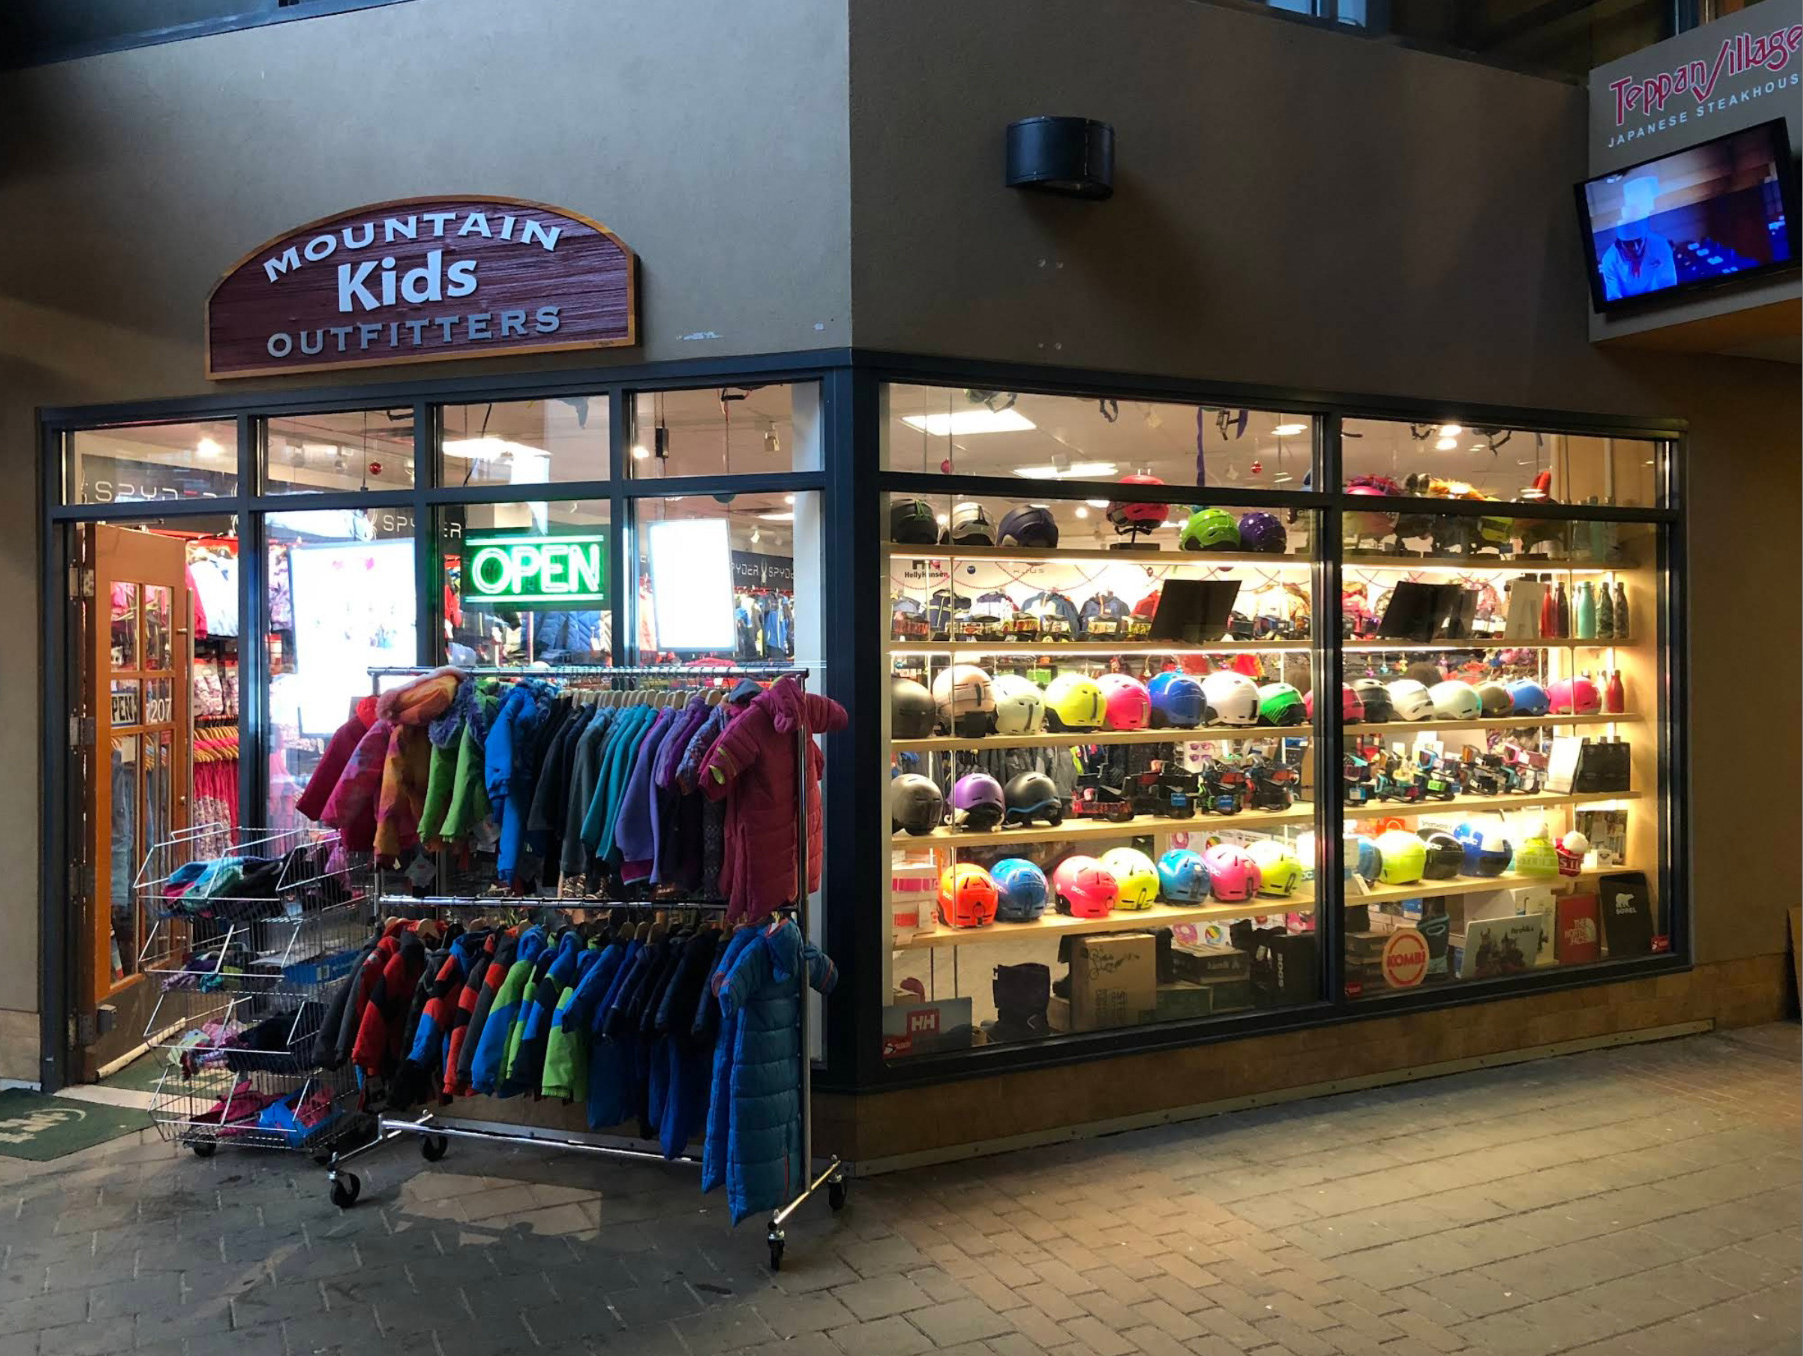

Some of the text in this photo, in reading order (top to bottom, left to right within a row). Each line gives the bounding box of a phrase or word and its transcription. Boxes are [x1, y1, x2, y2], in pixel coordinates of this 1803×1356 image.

[1609, 24, 1802, 126] Teppan Village
[1608, 73, 1799, 148] JAPANESE STEAKHOUS
[263, 212, 562, 284] MOUNTAIN
[337, 249, 479, 313] Kids
[266, 305, 561, 359] OUTFITTERS
[471, 543, 601, 594] OPEN
[111, 695, 134, 722] PEN
[1615, 907, 1637, 915] SOREL
[911, 1014, 936, 1032] HH
